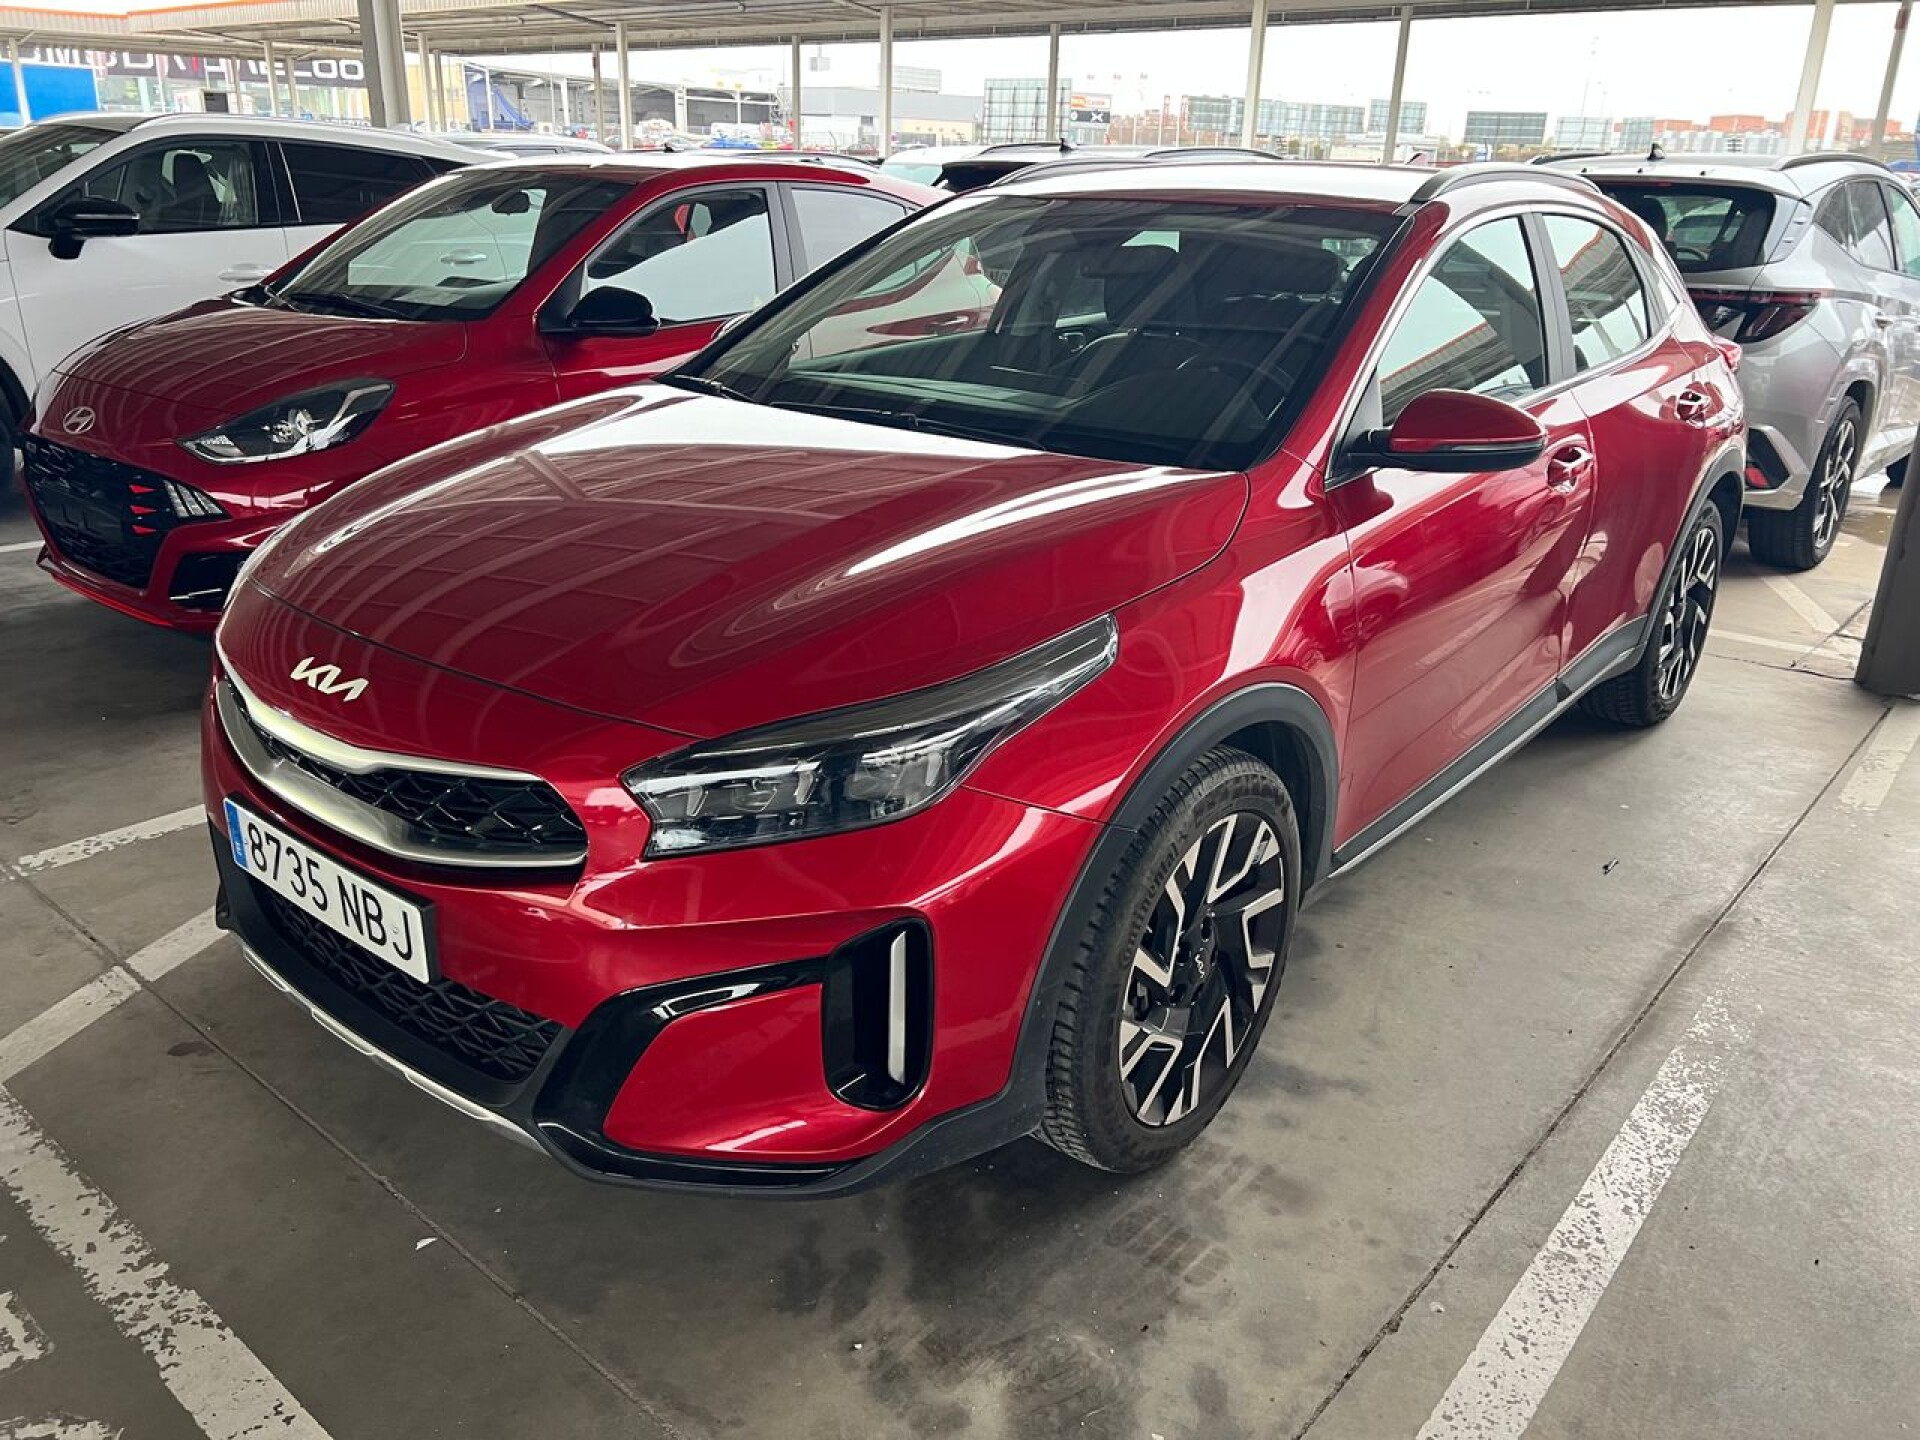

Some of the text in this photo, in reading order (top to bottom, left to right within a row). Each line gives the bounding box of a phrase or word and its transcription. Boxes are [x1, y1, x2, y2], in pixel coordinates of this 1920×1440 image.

[290, 656, 369, 702] KIA
[247, 821, 413, 961] 8735 NBJ
